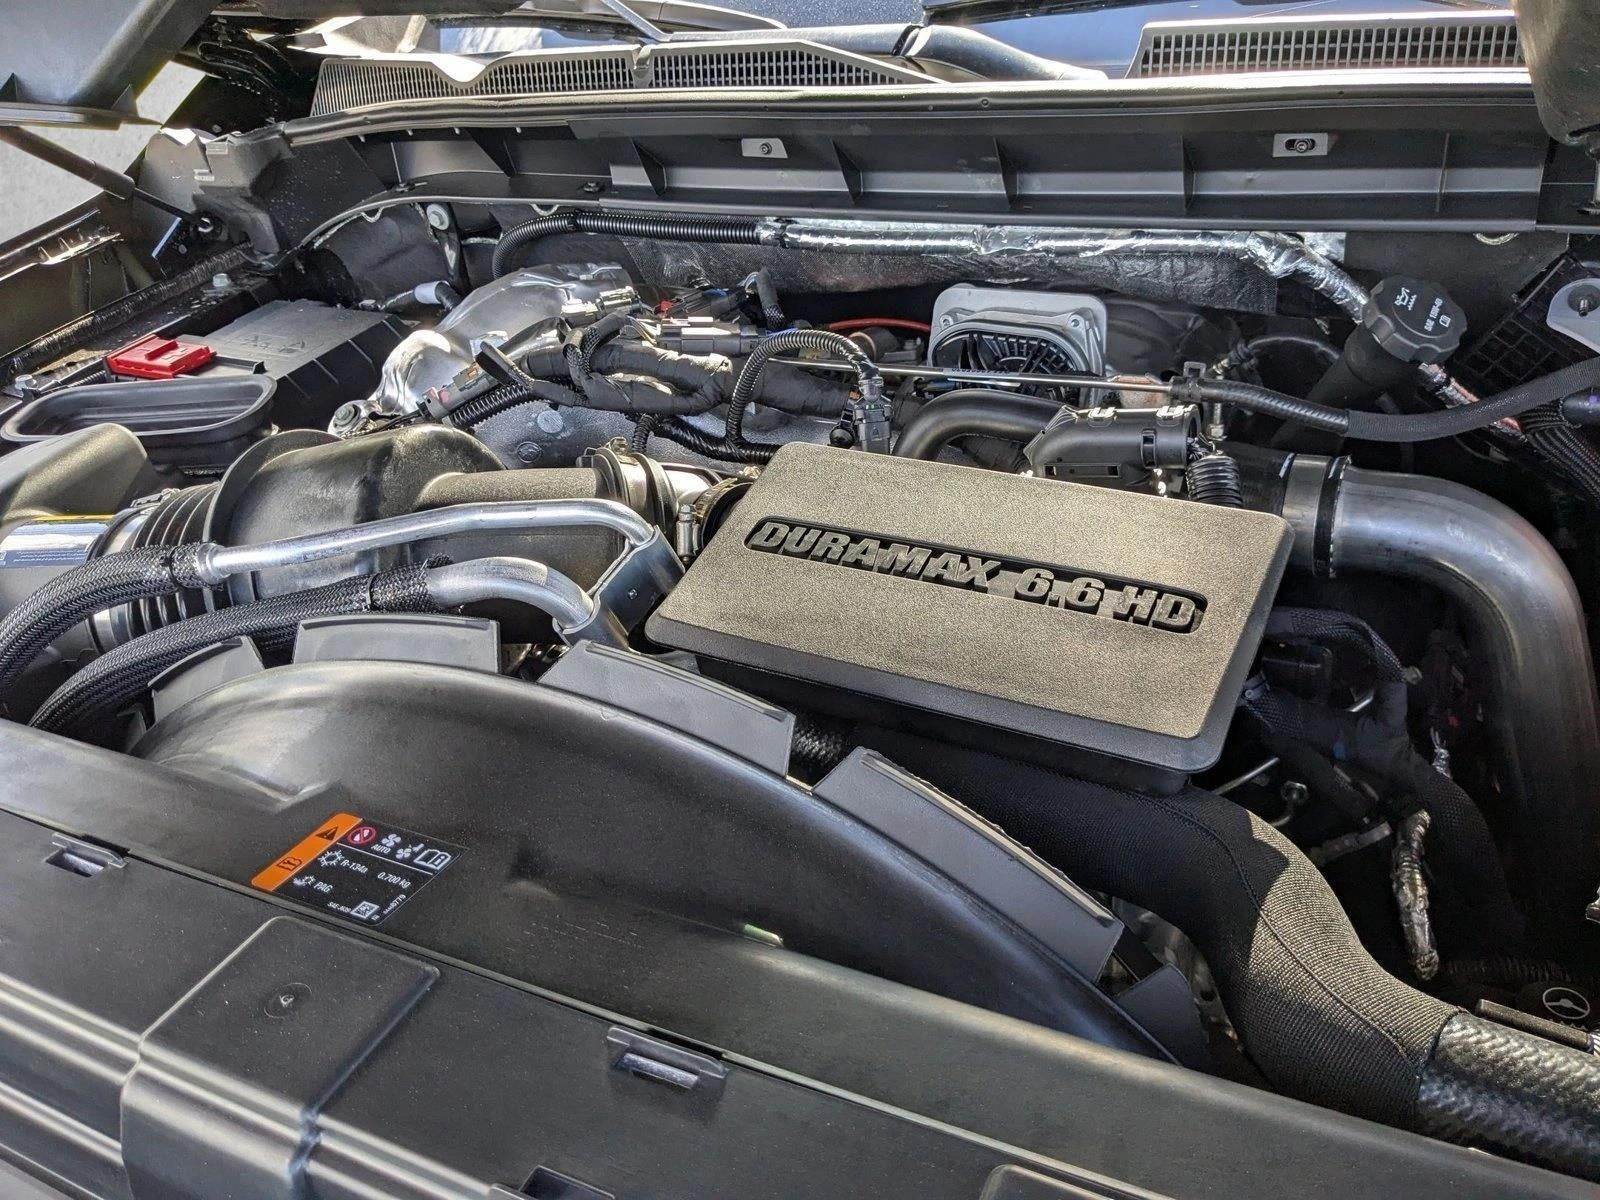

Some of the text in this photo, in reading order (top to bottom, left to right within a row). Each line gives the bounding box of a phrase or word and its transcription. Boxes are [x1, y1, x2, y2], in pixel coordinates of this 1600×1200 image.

[750, 521, 1197, 632] DURAMAX 6.6 HD
[371, 844, 391, 854] AUTO
[341, 860, 411, 889] R-134a 0.700 kg
[314, 882, 333, 892] PAG
